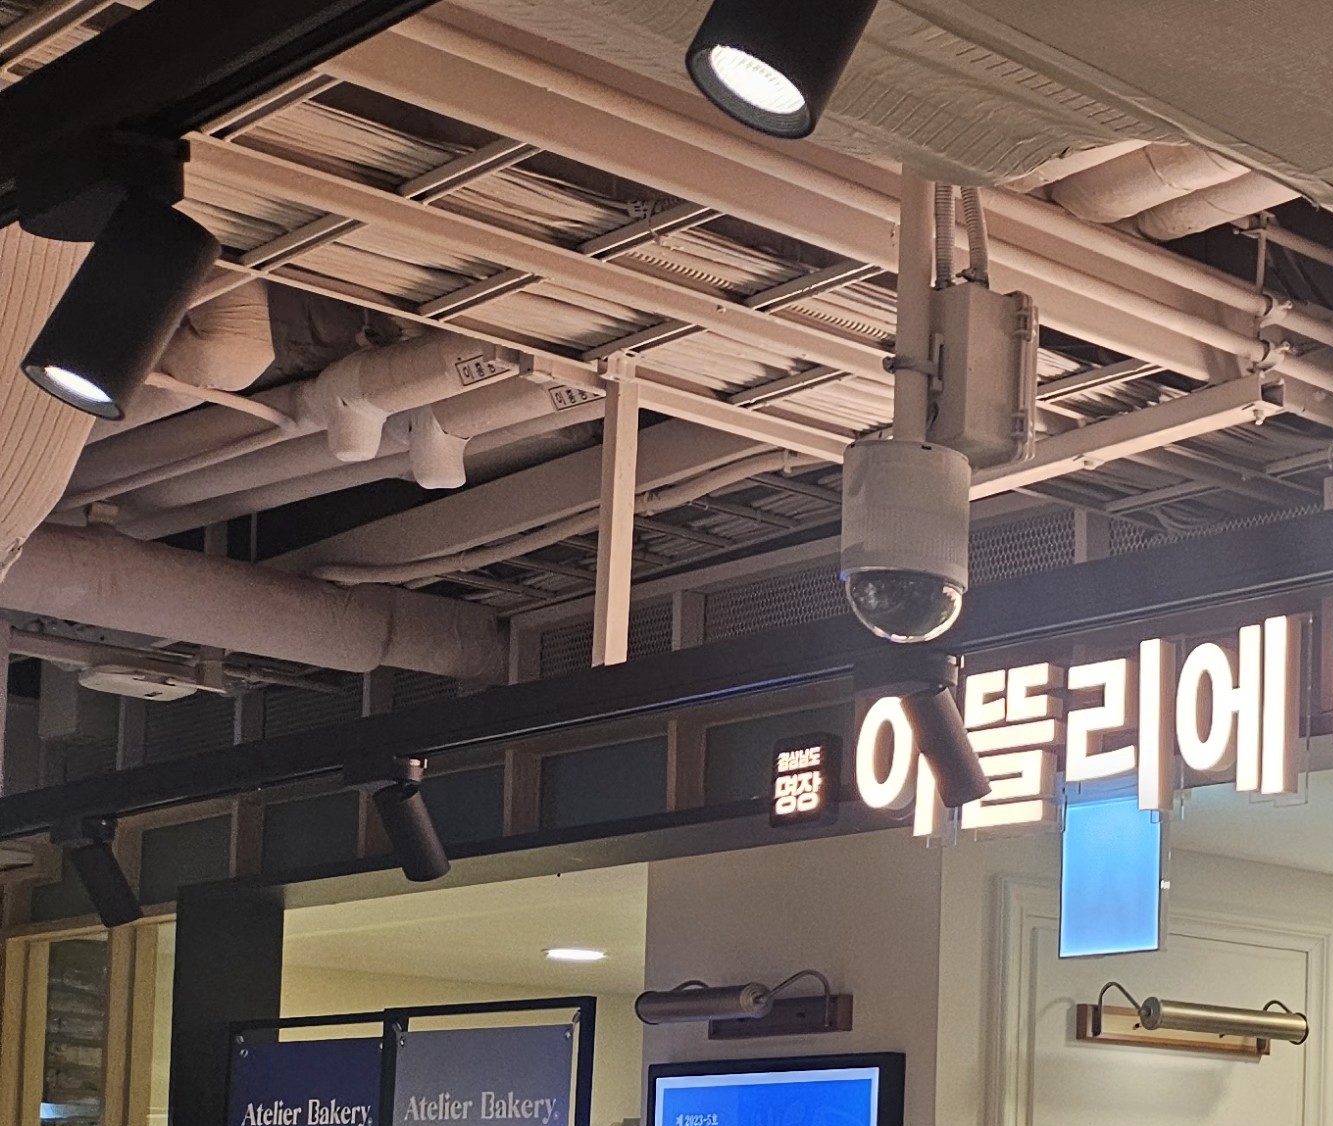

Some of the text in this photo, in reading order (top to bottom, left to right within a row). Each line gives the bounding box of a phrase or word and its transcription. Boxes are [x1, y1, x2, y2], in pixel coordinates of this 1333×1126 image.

[855, 614, 1290, 838] 아뜰리에
[776, 746, 821, 772] 경상남도
[775, 771, 823, 815] 명장
[241, 1099, 302, 1126] Atelier
[404, 1091, 473, 1121] Atelier
